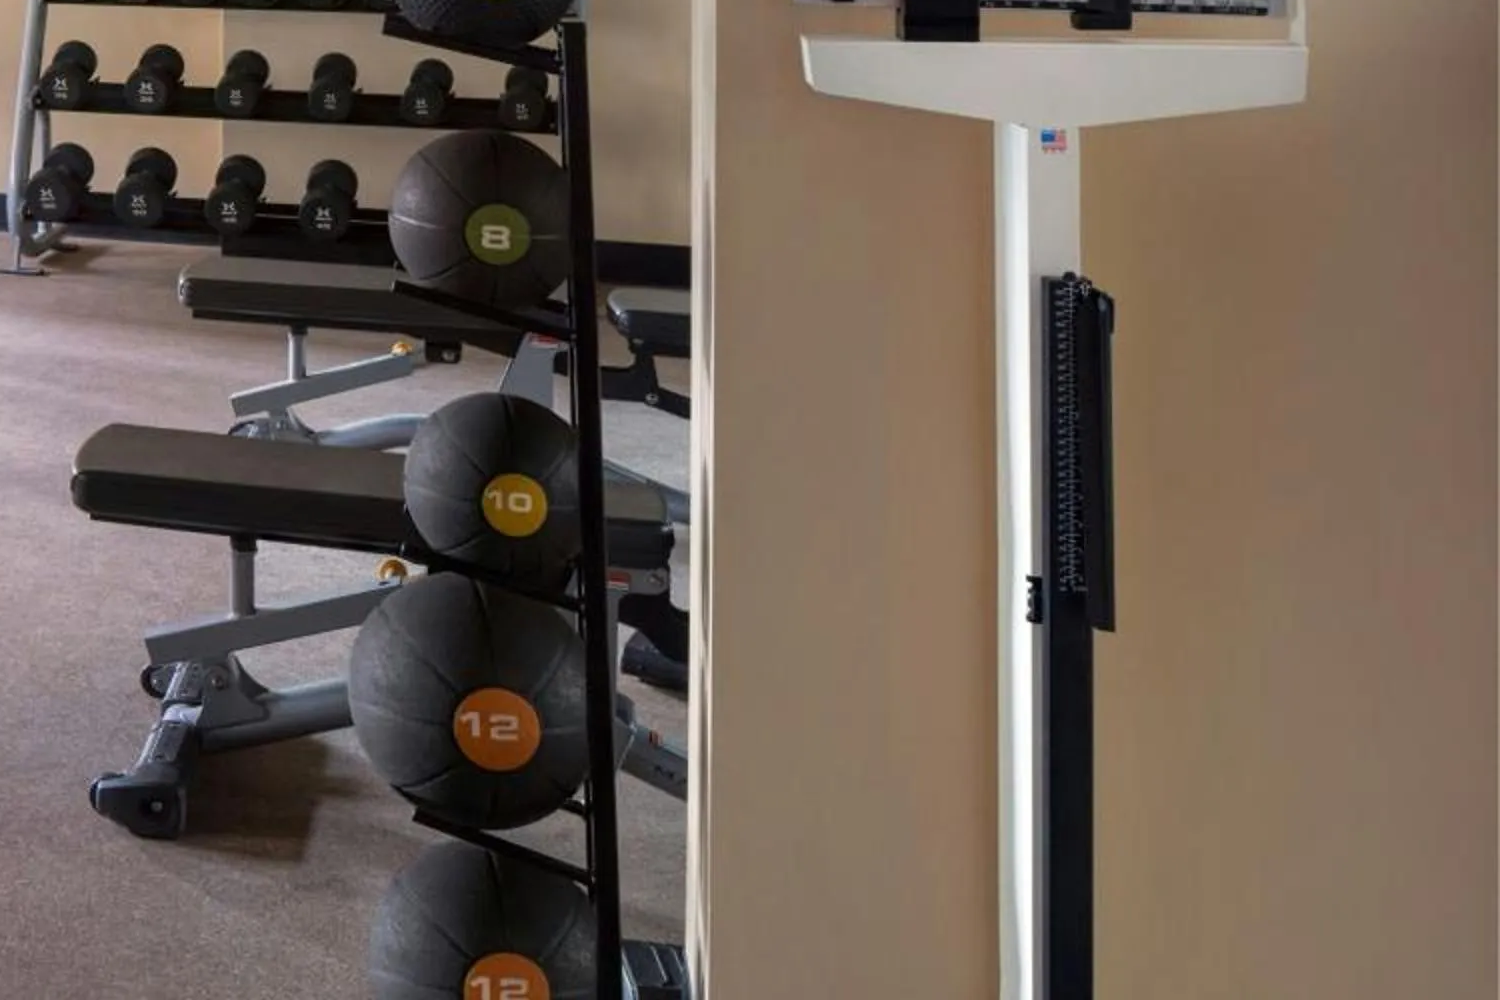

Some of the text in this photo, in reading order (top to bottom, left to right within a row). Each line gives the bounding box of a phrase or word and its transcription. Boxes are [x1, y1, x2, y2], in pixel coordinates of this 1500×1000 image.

[481, 224, 511, 251] 8
[486, 488, 534, 514] 10
[459, 711, 520, 742] 12
[471, 976, 530, 1000] 12
